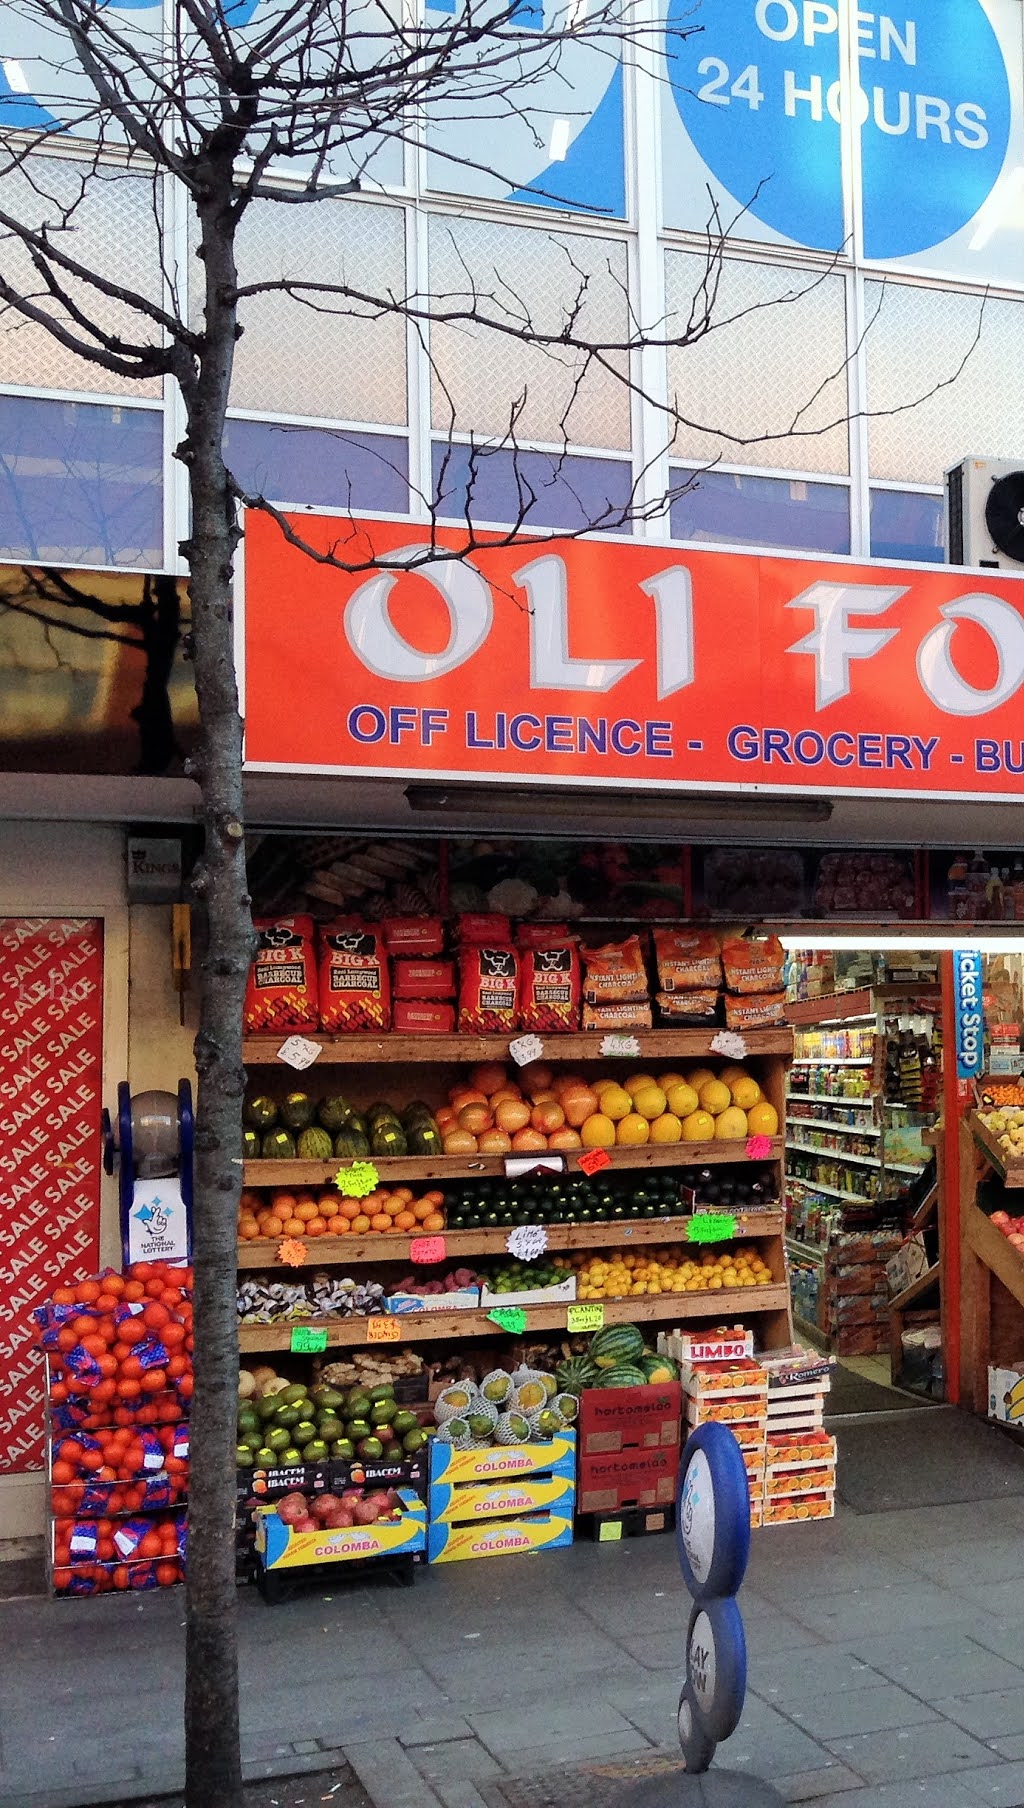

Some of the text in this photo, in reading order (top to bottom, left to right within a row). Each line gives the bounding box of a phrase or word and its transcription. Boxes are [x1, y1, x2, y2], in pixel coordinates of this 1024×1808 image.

[755, 0, 917, 65] OPEN
[697, 57, 990, 150] 24 HOURS
[343, 543, 695, 701] OLI
[346, 704, 449, 747] OFF
[465, 712, 673, 758] LICENCE
[727, 724, 941, 771] GROCERY
[2, 944, 51, 989] SALE
[48, 939, 97, 984] SALE
[257, 947, 305, 962] BIG K
[330, 951, 380, 966] BIG K
[48, 976, 97, 1021] SALE
[333, 974, 378, 982] BARBECUE
[333, 980, 378, 988] CHARCOAL
[480, 977, 516, 989] BIG K
[533, 972, 571, 984] BIG K
[2, 980, 51, 1025] SALE
[600, 1011, 637, 1019] CHARCOAL
[959, 951, 981, 1069] icket Stop
[1, 1016, 51, 1062] SALE
[47, 1012, 96, 1057] SALE
[0, 1053, 50, 1099] SALE
[47, 1048, 96, 1093] SALE
[0, 1089, 50, 1136] SALE
[46, 1084, 96, 1130] SALE
[0, 1126, 49, 1172] SALE
[45, 1121, 95, 1166] SALE
[0, 1163, 49, 1210] SALE
[45, 1157, 95, 1203] SALE
[0, 1199, 48, 1247] SALE
[44, 1193, 94, 1240] SALE
[0, 1236, 48, 1284] SALE
[43, 1230, 93, 1277] SALE
[141, 1240, 175, 1248] NATIONAL
[143, 1246, 174, 1254] LOTTERY
[0, 1273, 47, 1322] SALE
[0, 1349, 45, 1397] SALE
[690, 1344, 745, 1358] LIMBO
[789, 1366, 831, 1382] Romero
[0, 1385, 44, 1433] SALE
[0, 1422, 44, 1468] SALE
[474, 1458, 533, 1473] COLOMBA
[474, 1497, 533, 1512] COLOMBA
[315, 1540, 380, 1556] COLOMBA
[471, 1537, 530, 1552] COLOMBA
